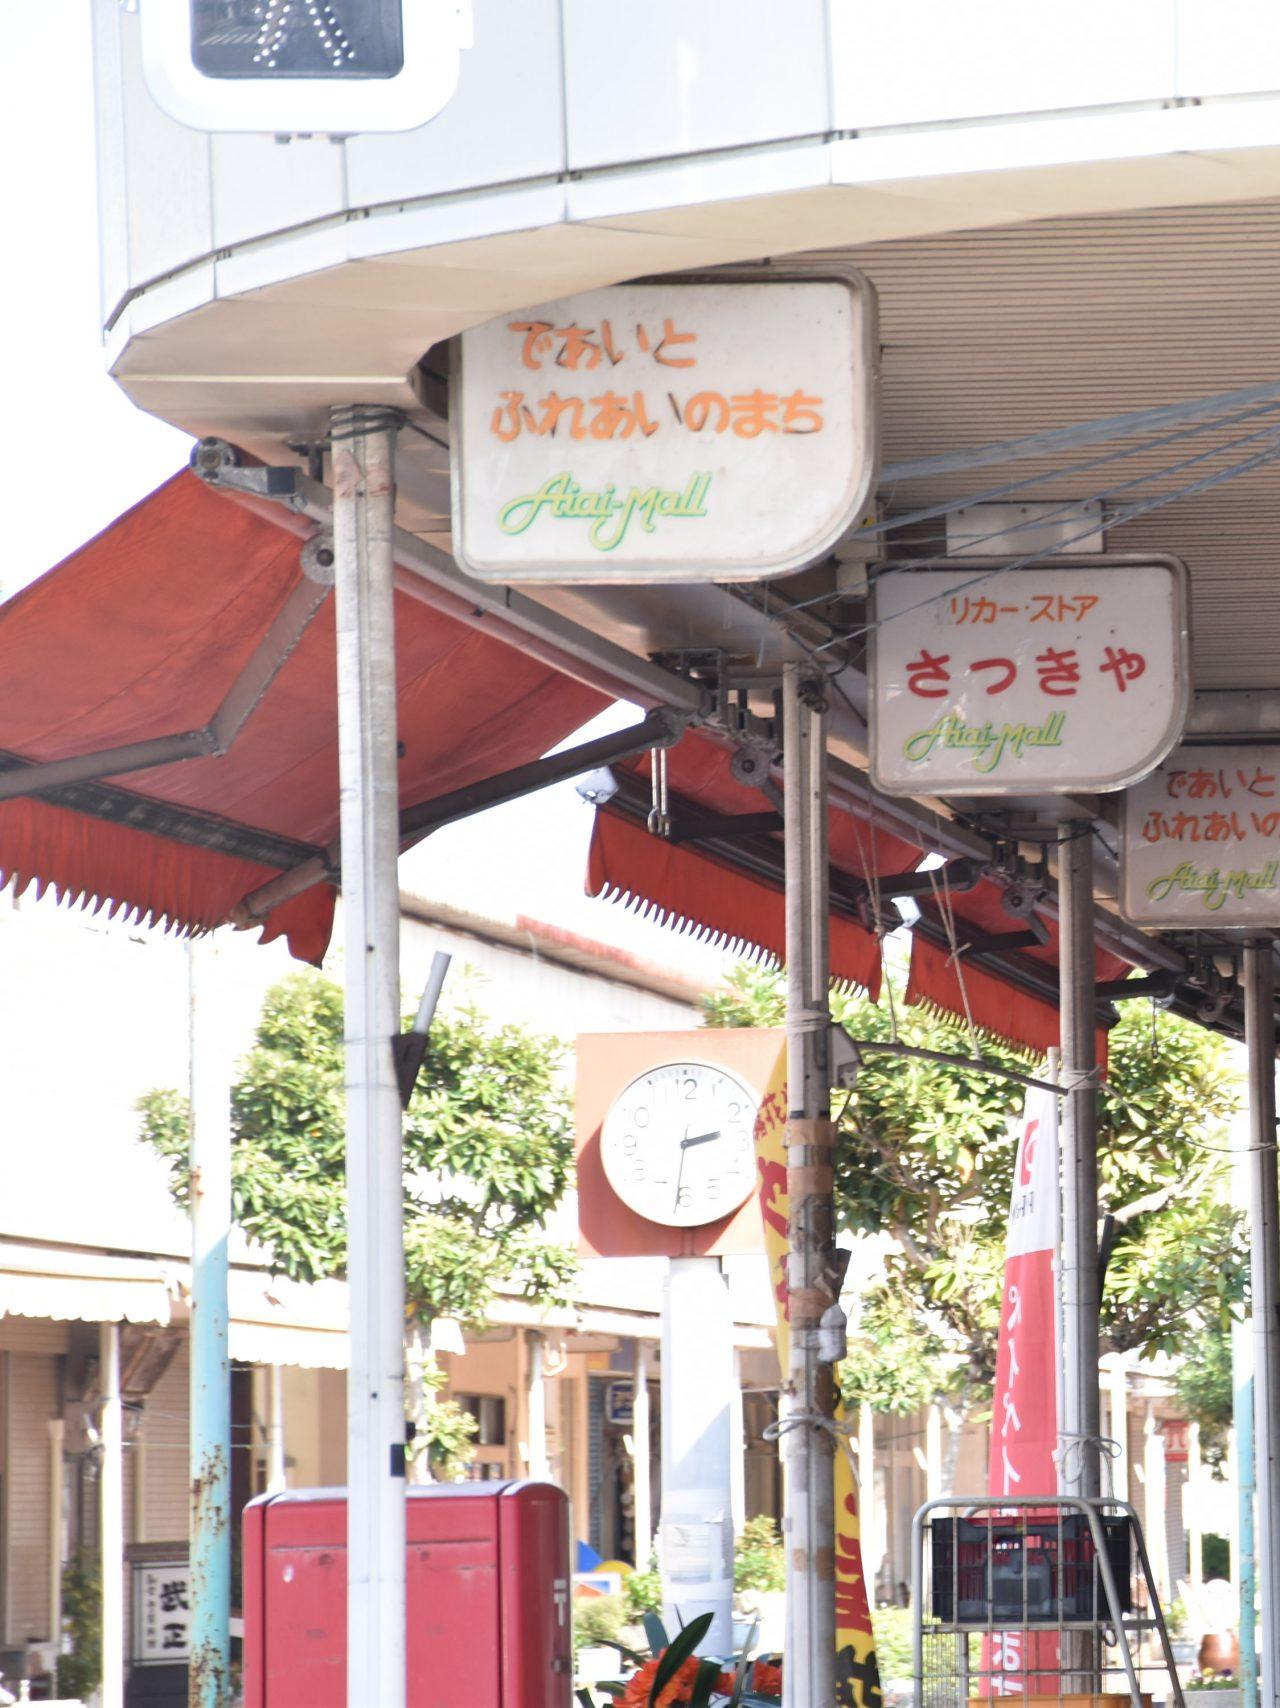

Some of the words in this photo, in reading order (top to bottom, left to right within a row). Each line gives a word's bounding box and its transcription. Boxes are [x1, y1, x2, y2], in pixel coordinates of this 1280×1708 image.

[507, 318, 698, 371] であいと
[490, 388, 825, 443] ふれあいのまち
[905, 645, 1146, 699] さつきや
[1166, 767, 1276, 799] であいと
